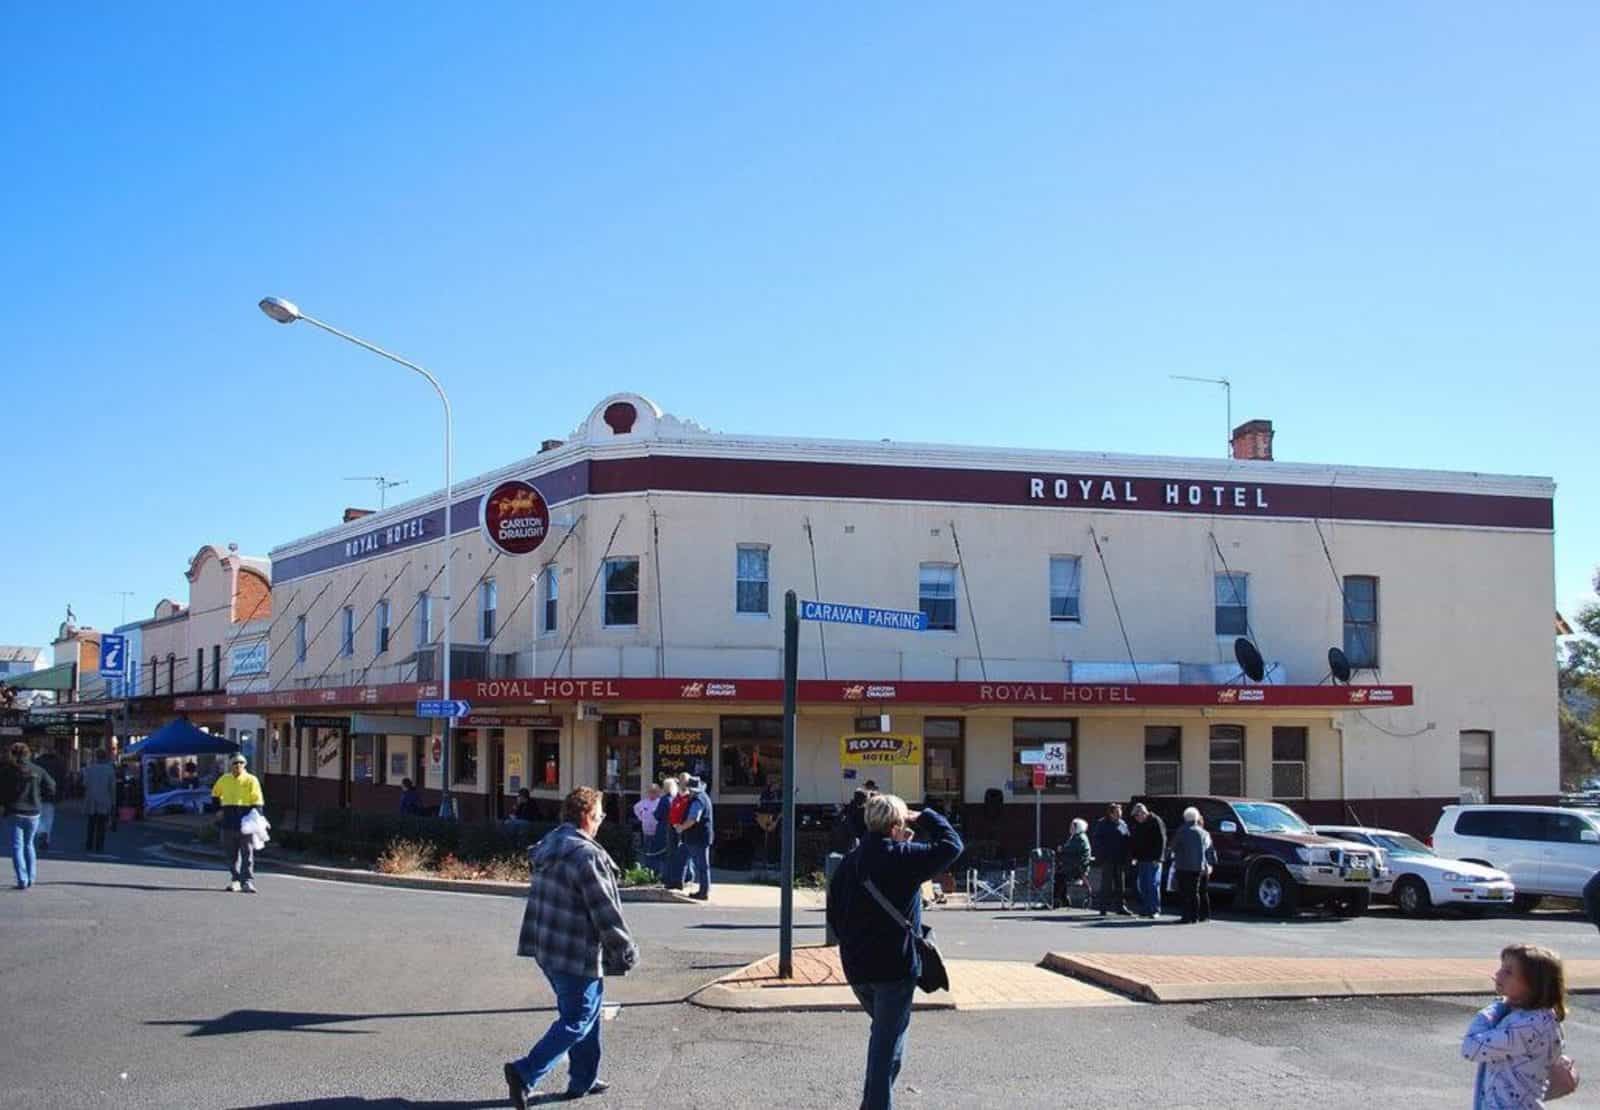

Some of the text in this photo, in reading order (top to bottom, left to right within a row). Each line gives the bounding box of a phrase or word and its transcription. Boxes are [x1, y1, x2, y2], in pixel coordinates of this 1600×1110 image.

[1030, 478, 1268, 508] ROYAL HOTEL
[500, 518, 542, 529] CARLTON
[345, 518, 424, 557] ROYAL HOTEL
[499, 527, 544, 540] DRAUGHT
[805, 603, 921, 629] CARAVAN PARKING
[477, 680, 620, 697] ROYAL HOTEL
[980, 685, 1136, 701] ROYAL HOTEL
[658, 744, 709, 755] PUB STAY
[848, 739, 897, 750] ROYAL
